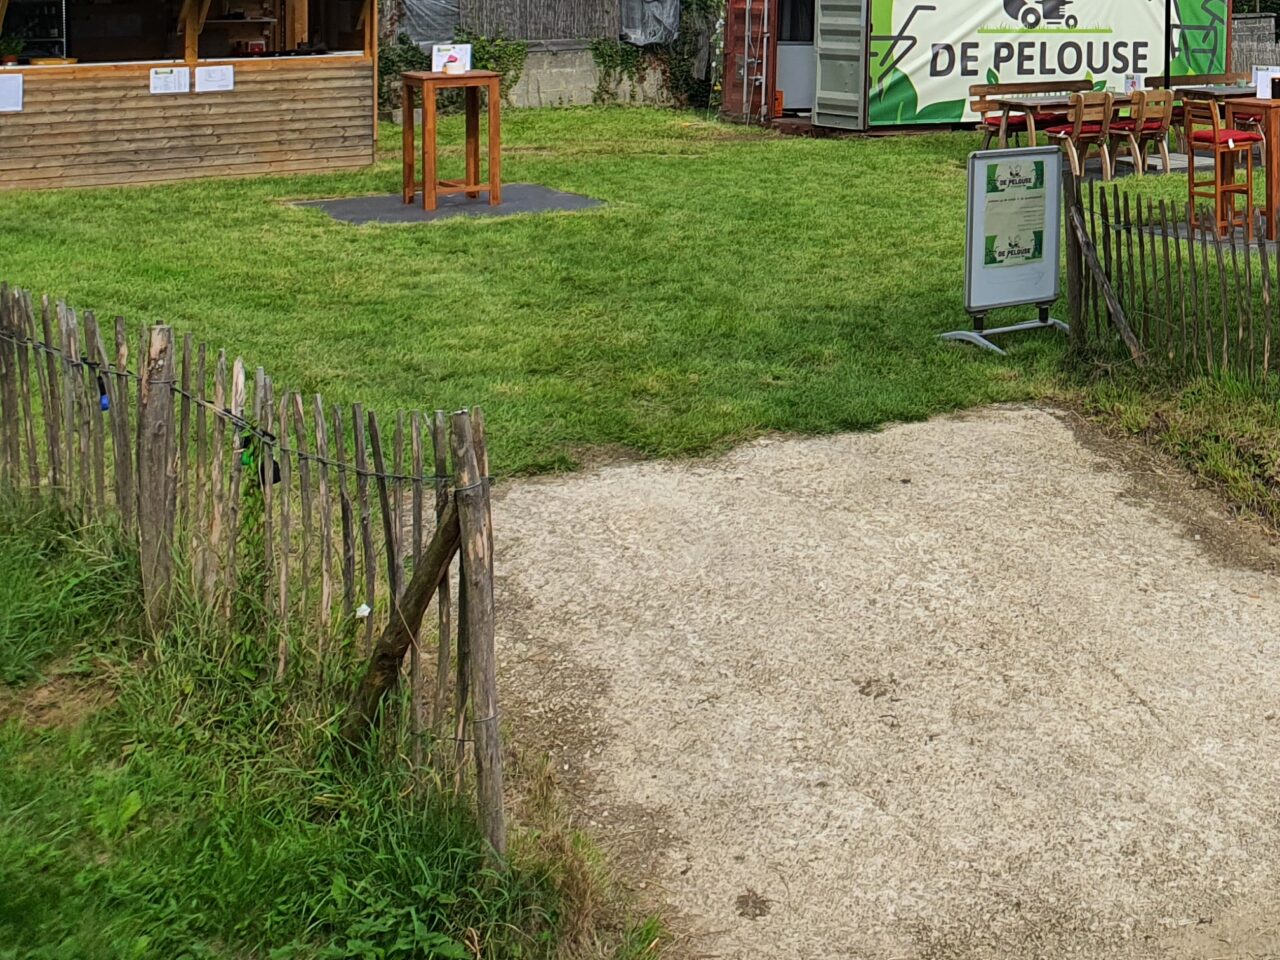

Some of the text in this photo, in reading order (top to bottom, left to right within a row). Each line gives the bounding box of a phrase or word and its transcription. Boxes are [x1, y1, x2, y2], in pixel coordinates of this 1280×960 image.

[930, 41, 1149, 76] DE PELOUSE
[1008, 178, 1032, 188] PELOUSE
[1006, 248, 1031, 259] PELOUSE
